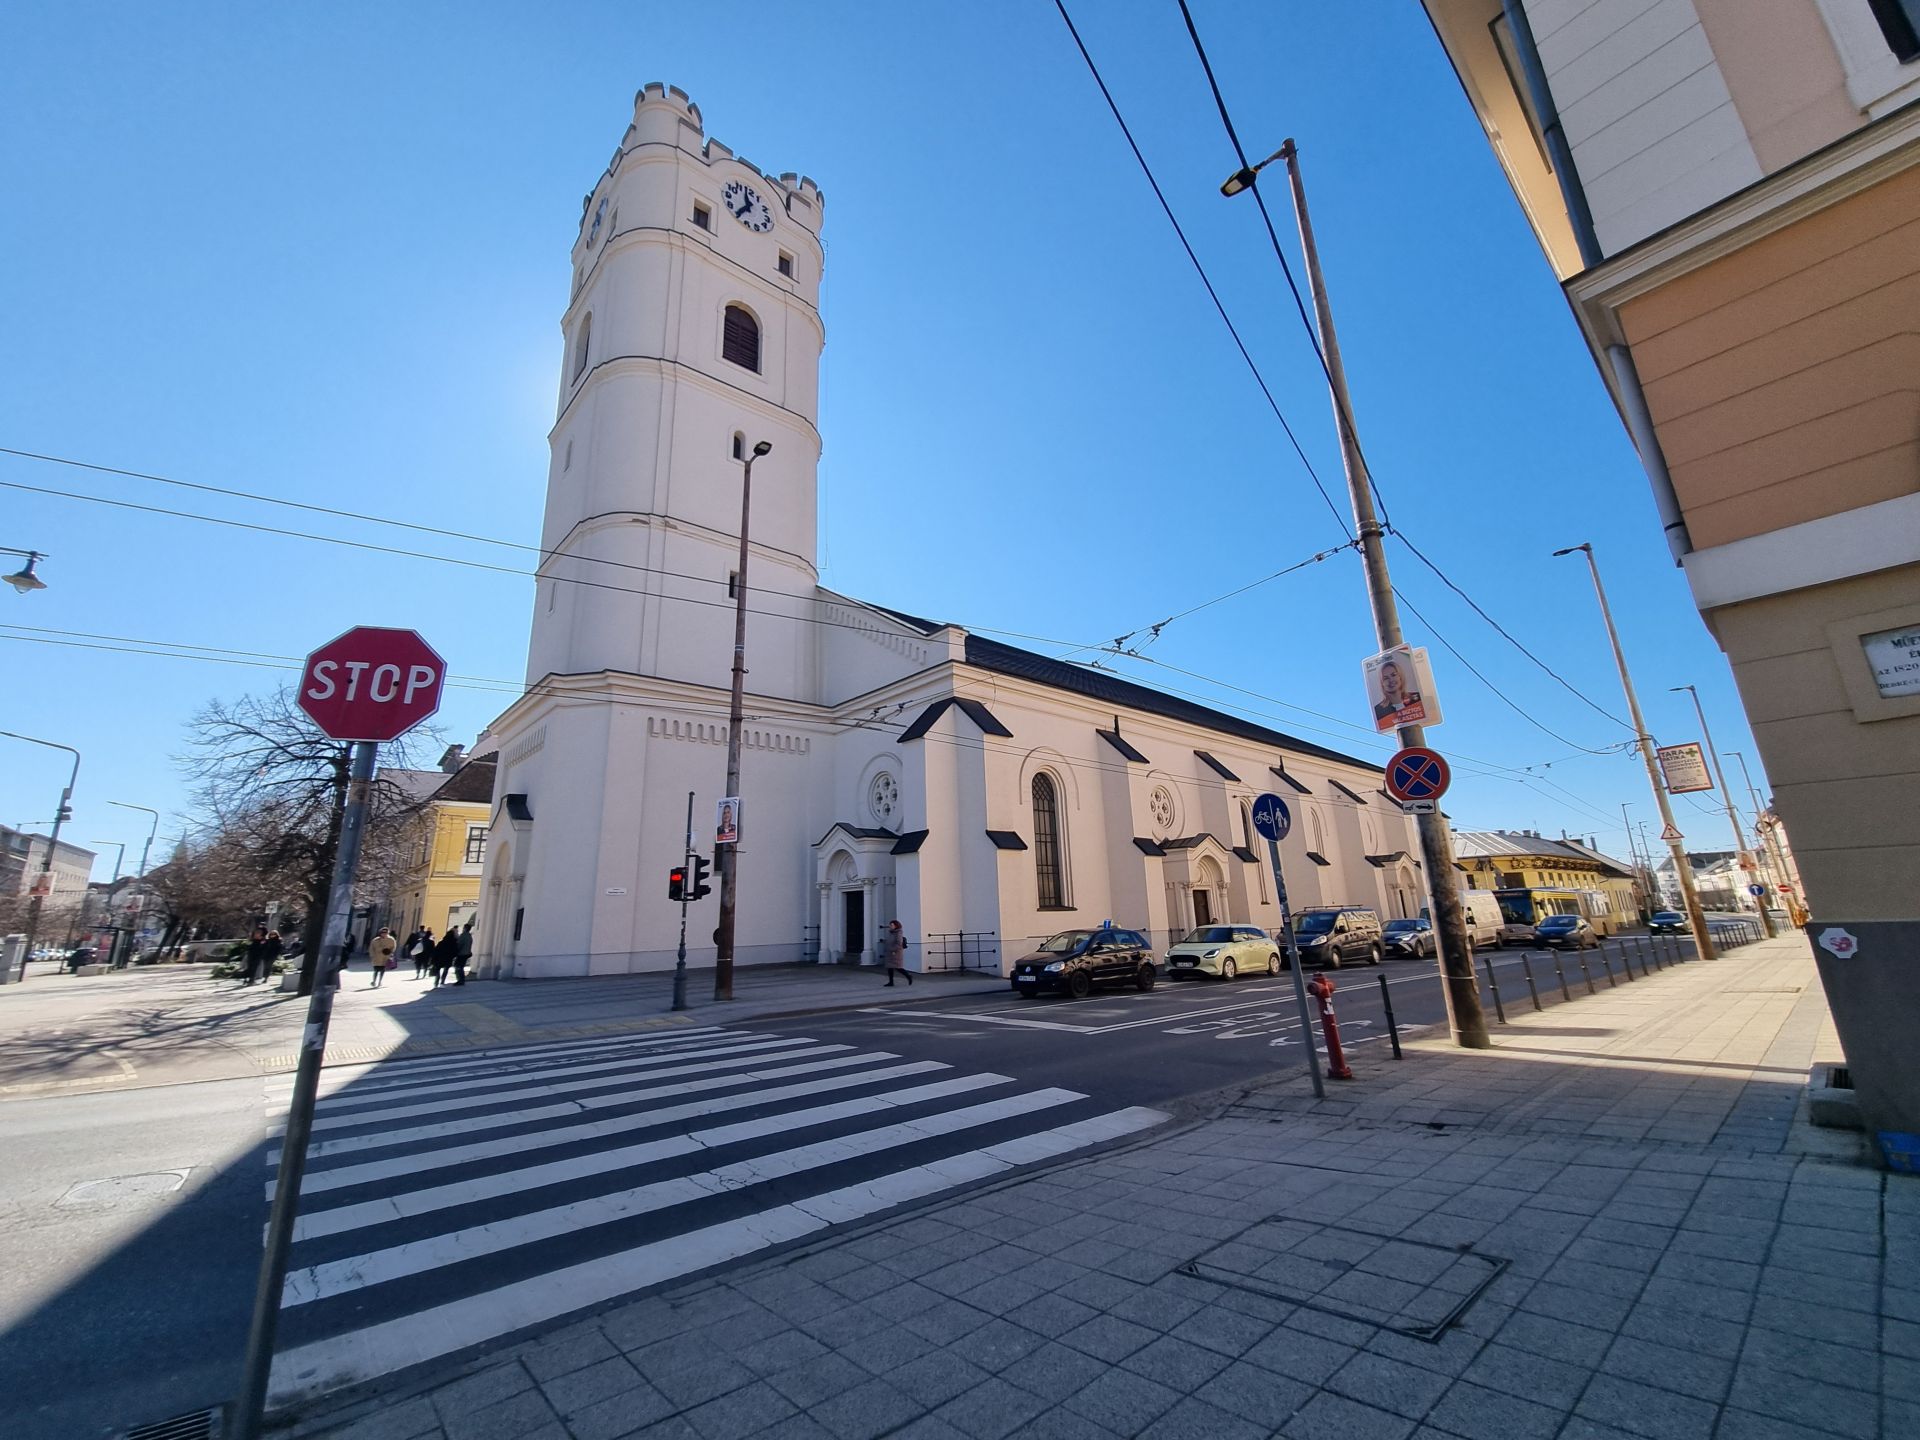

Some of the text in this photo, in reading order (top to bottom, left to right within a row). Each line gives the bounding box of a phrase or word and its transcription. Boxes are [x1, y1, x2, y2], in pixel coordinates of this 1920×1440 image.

[726, 182, 738, 194] 10
[725, 190, 732, 199] 9
[727, 200, 734, 210] 8
[762, 205, 768, 214] 2
[764, 215, 771, 223] 3
[1891, 636, 1920, 648] MŰE
[307, 660, 436, 705] STOP
[1660, 750, 1685, 758] TARA
